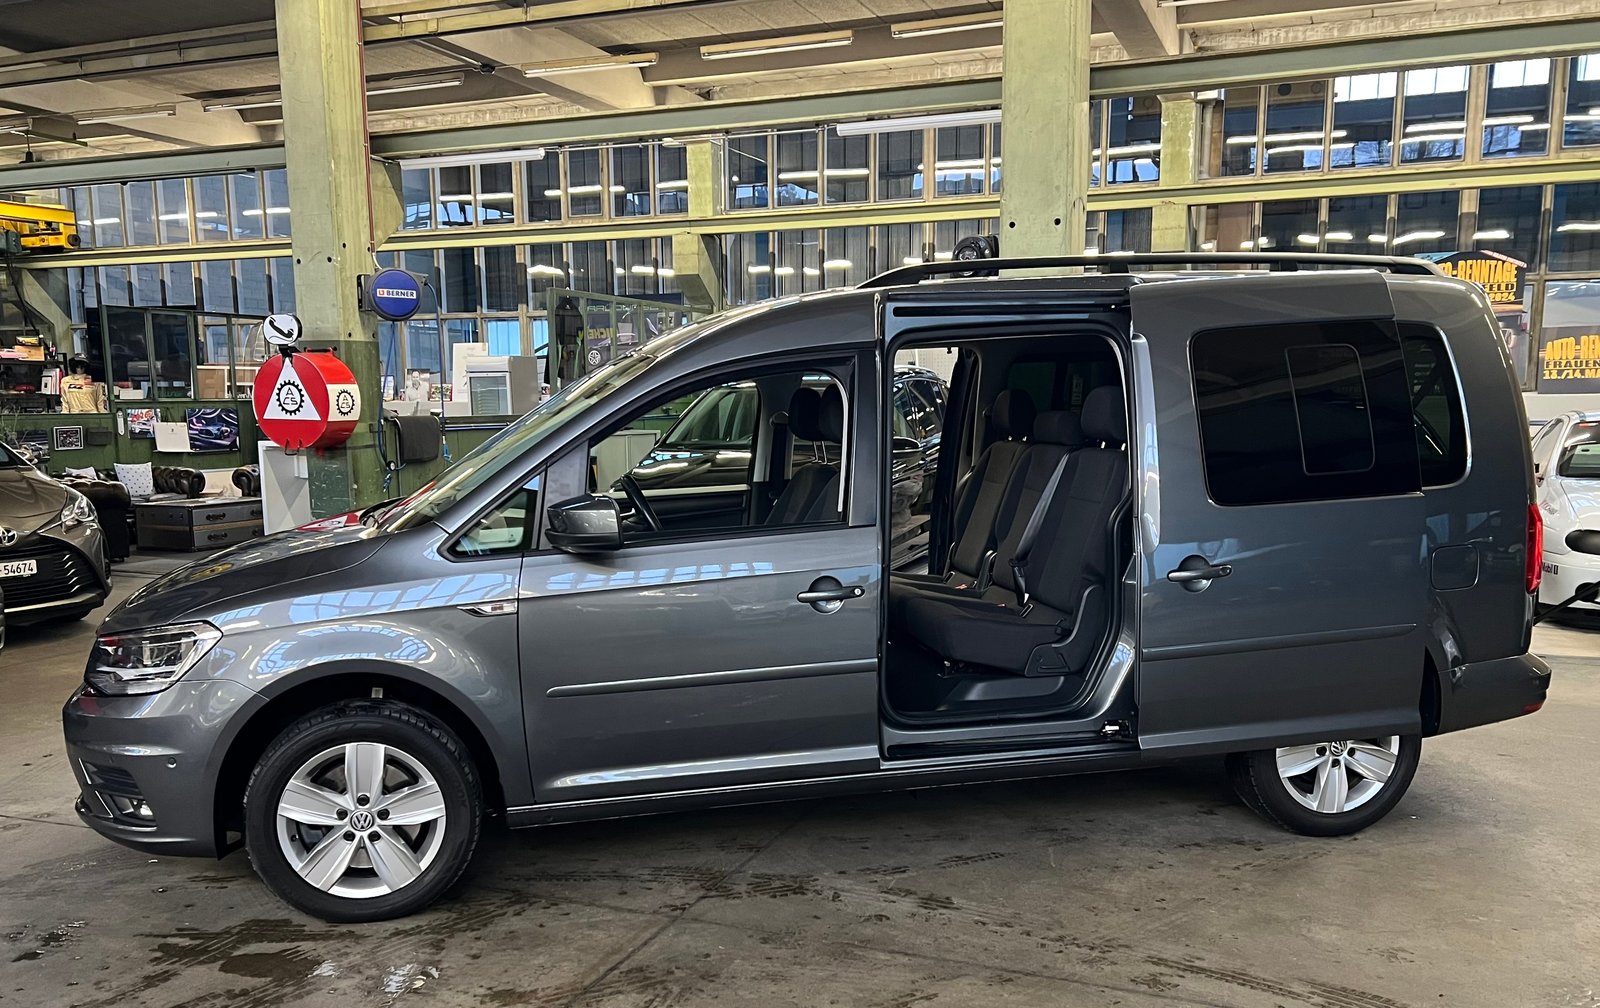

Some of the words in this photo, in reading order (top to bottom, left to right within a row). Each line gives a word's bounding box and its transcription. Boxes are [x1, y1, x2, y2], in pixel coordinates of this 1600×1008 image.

[386, 290, 415, 298] BERNER
[1489, 292, 1516, 302] 2024
[3, 563, 34, 575] 54674
